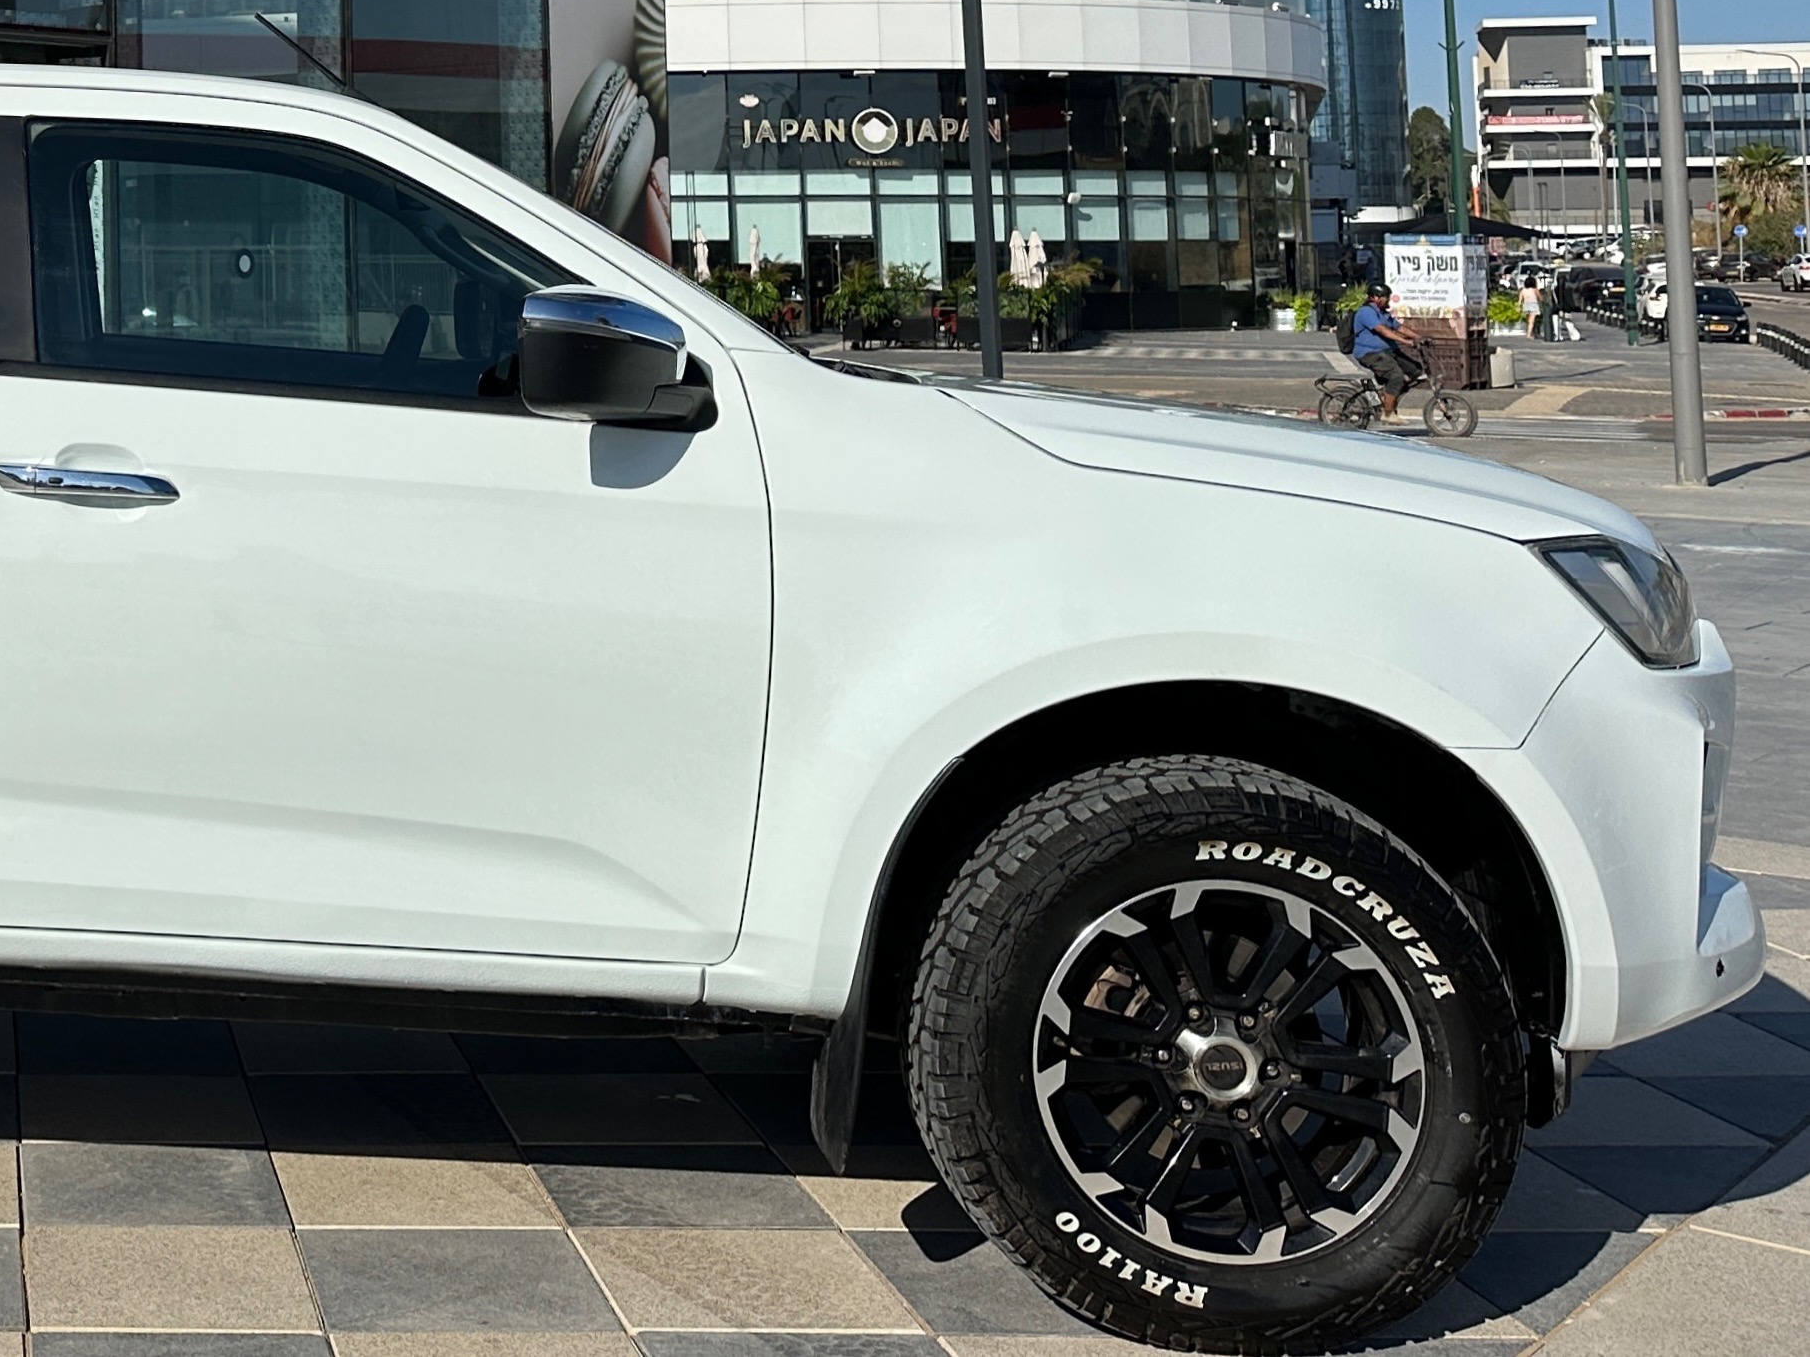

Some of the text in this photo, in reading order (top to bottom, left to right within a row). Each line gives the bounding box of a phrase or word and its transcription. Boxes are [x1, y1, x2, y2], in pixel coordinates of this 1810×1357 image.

[742, 118, 846, 148] JAPAN
[1195, 839, 1456, 1001] ROADCRUZA
[1055, 1210, 1209, 1309] RA1100
